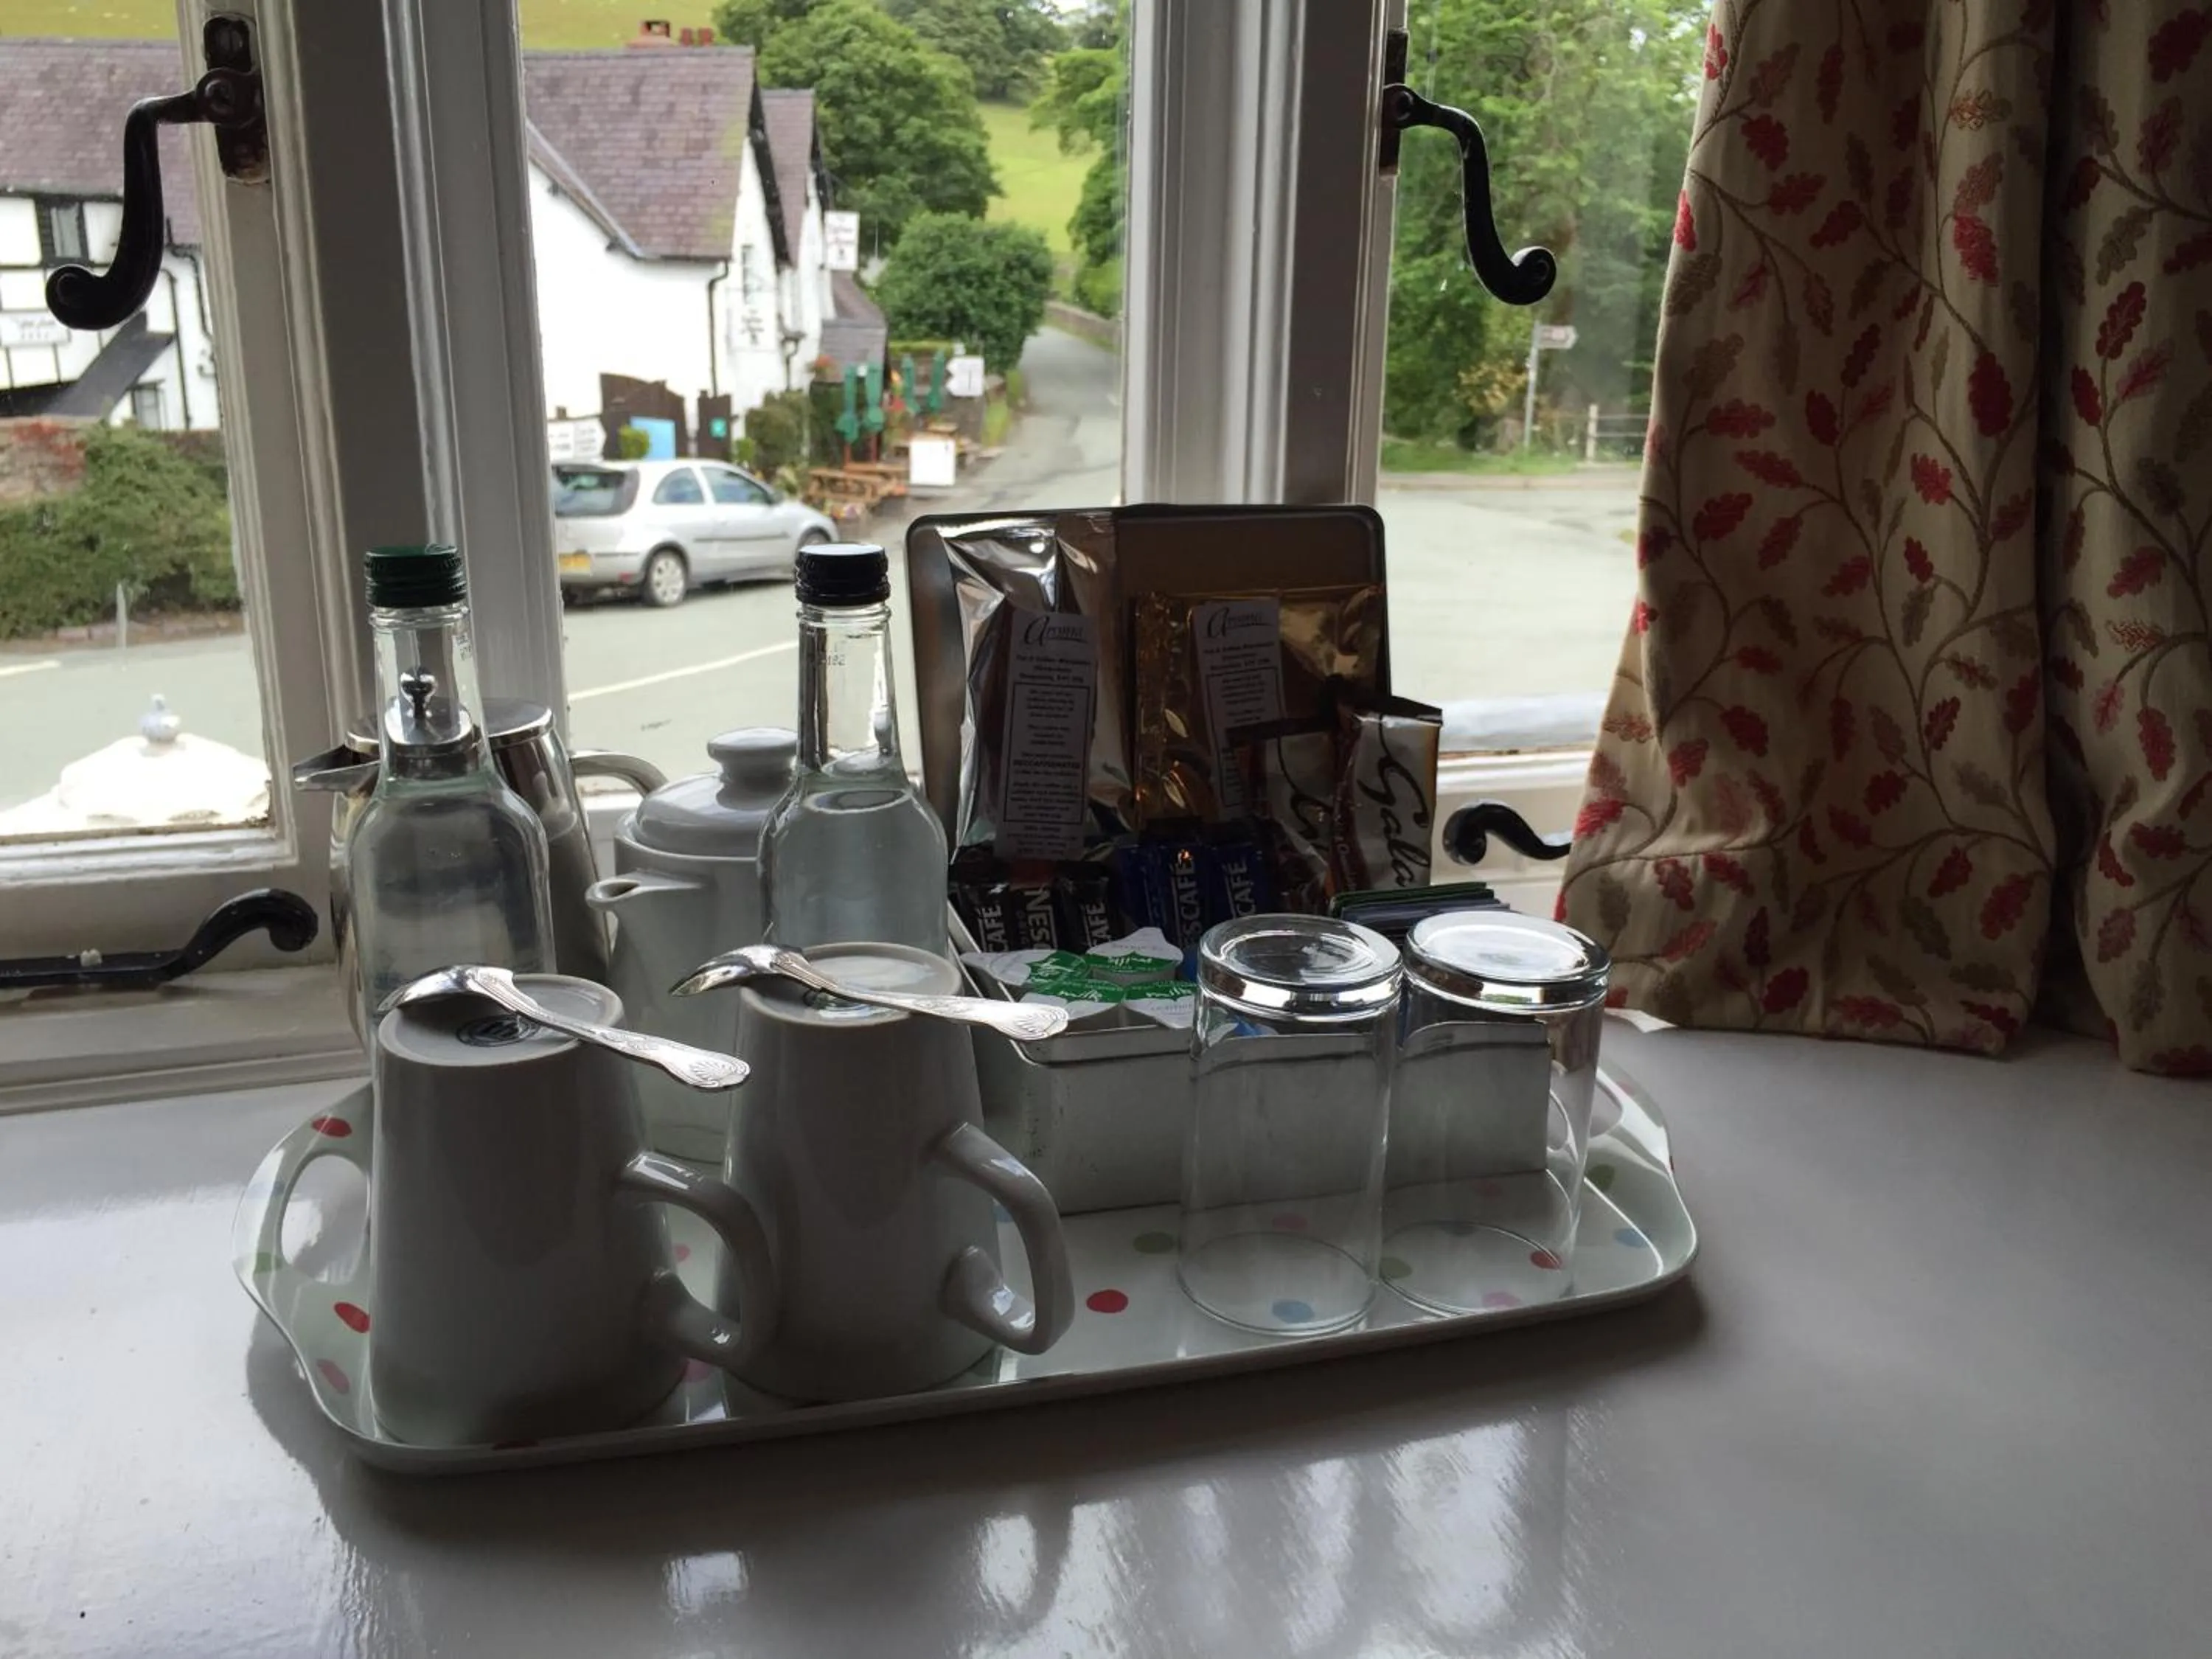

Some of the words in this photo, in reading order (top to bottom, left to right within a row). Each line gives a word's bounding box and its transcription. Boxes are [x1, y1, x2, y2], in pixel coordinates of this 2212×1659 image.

[1357, 714, 1431, 887] Gala
[1169, 857, 1203, 947] SCAFÉ
[1222, 857, 1255, 919] CAFÉ
[976, 905, 1009, 952] CAFÉ
